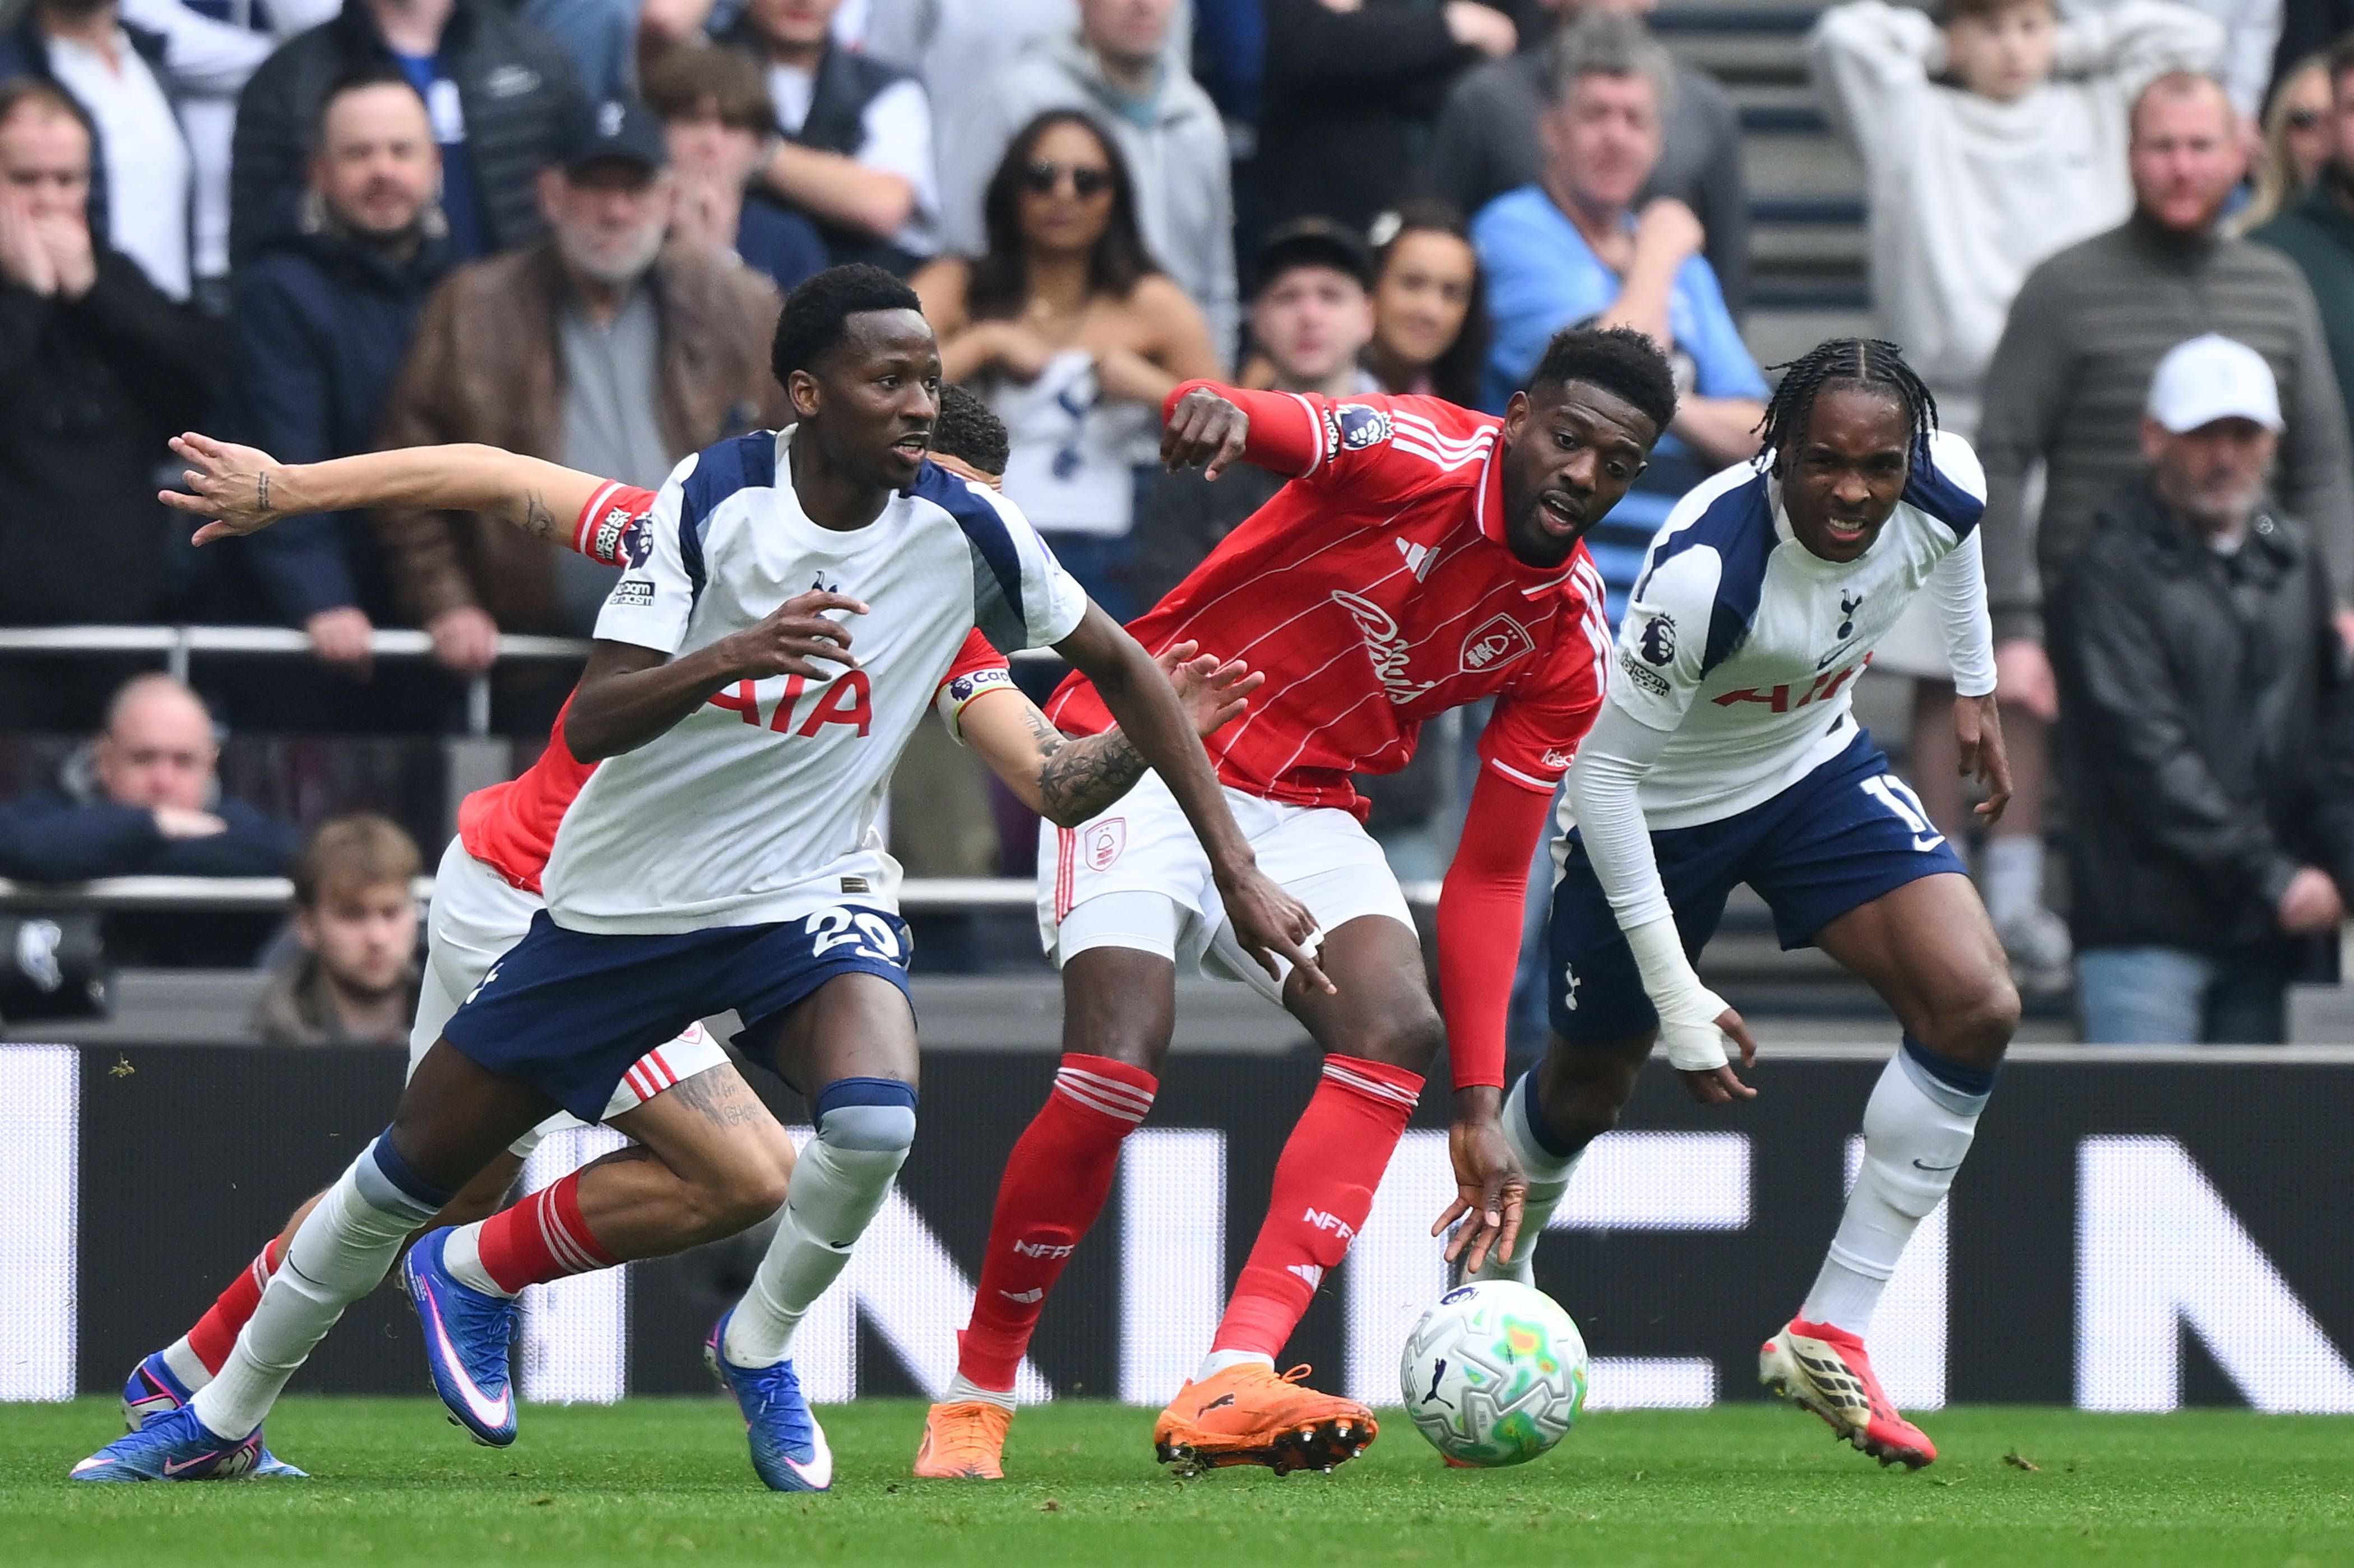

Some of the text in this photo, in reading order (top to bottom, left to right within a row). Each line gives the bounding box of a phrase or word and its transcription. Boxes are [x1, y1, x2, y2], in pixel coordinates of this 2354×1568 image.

[1860, 774, 1940, 834] 11
[804, 906, 900, 959] 29
[1303, 1206, 1356, 1255] NFF
